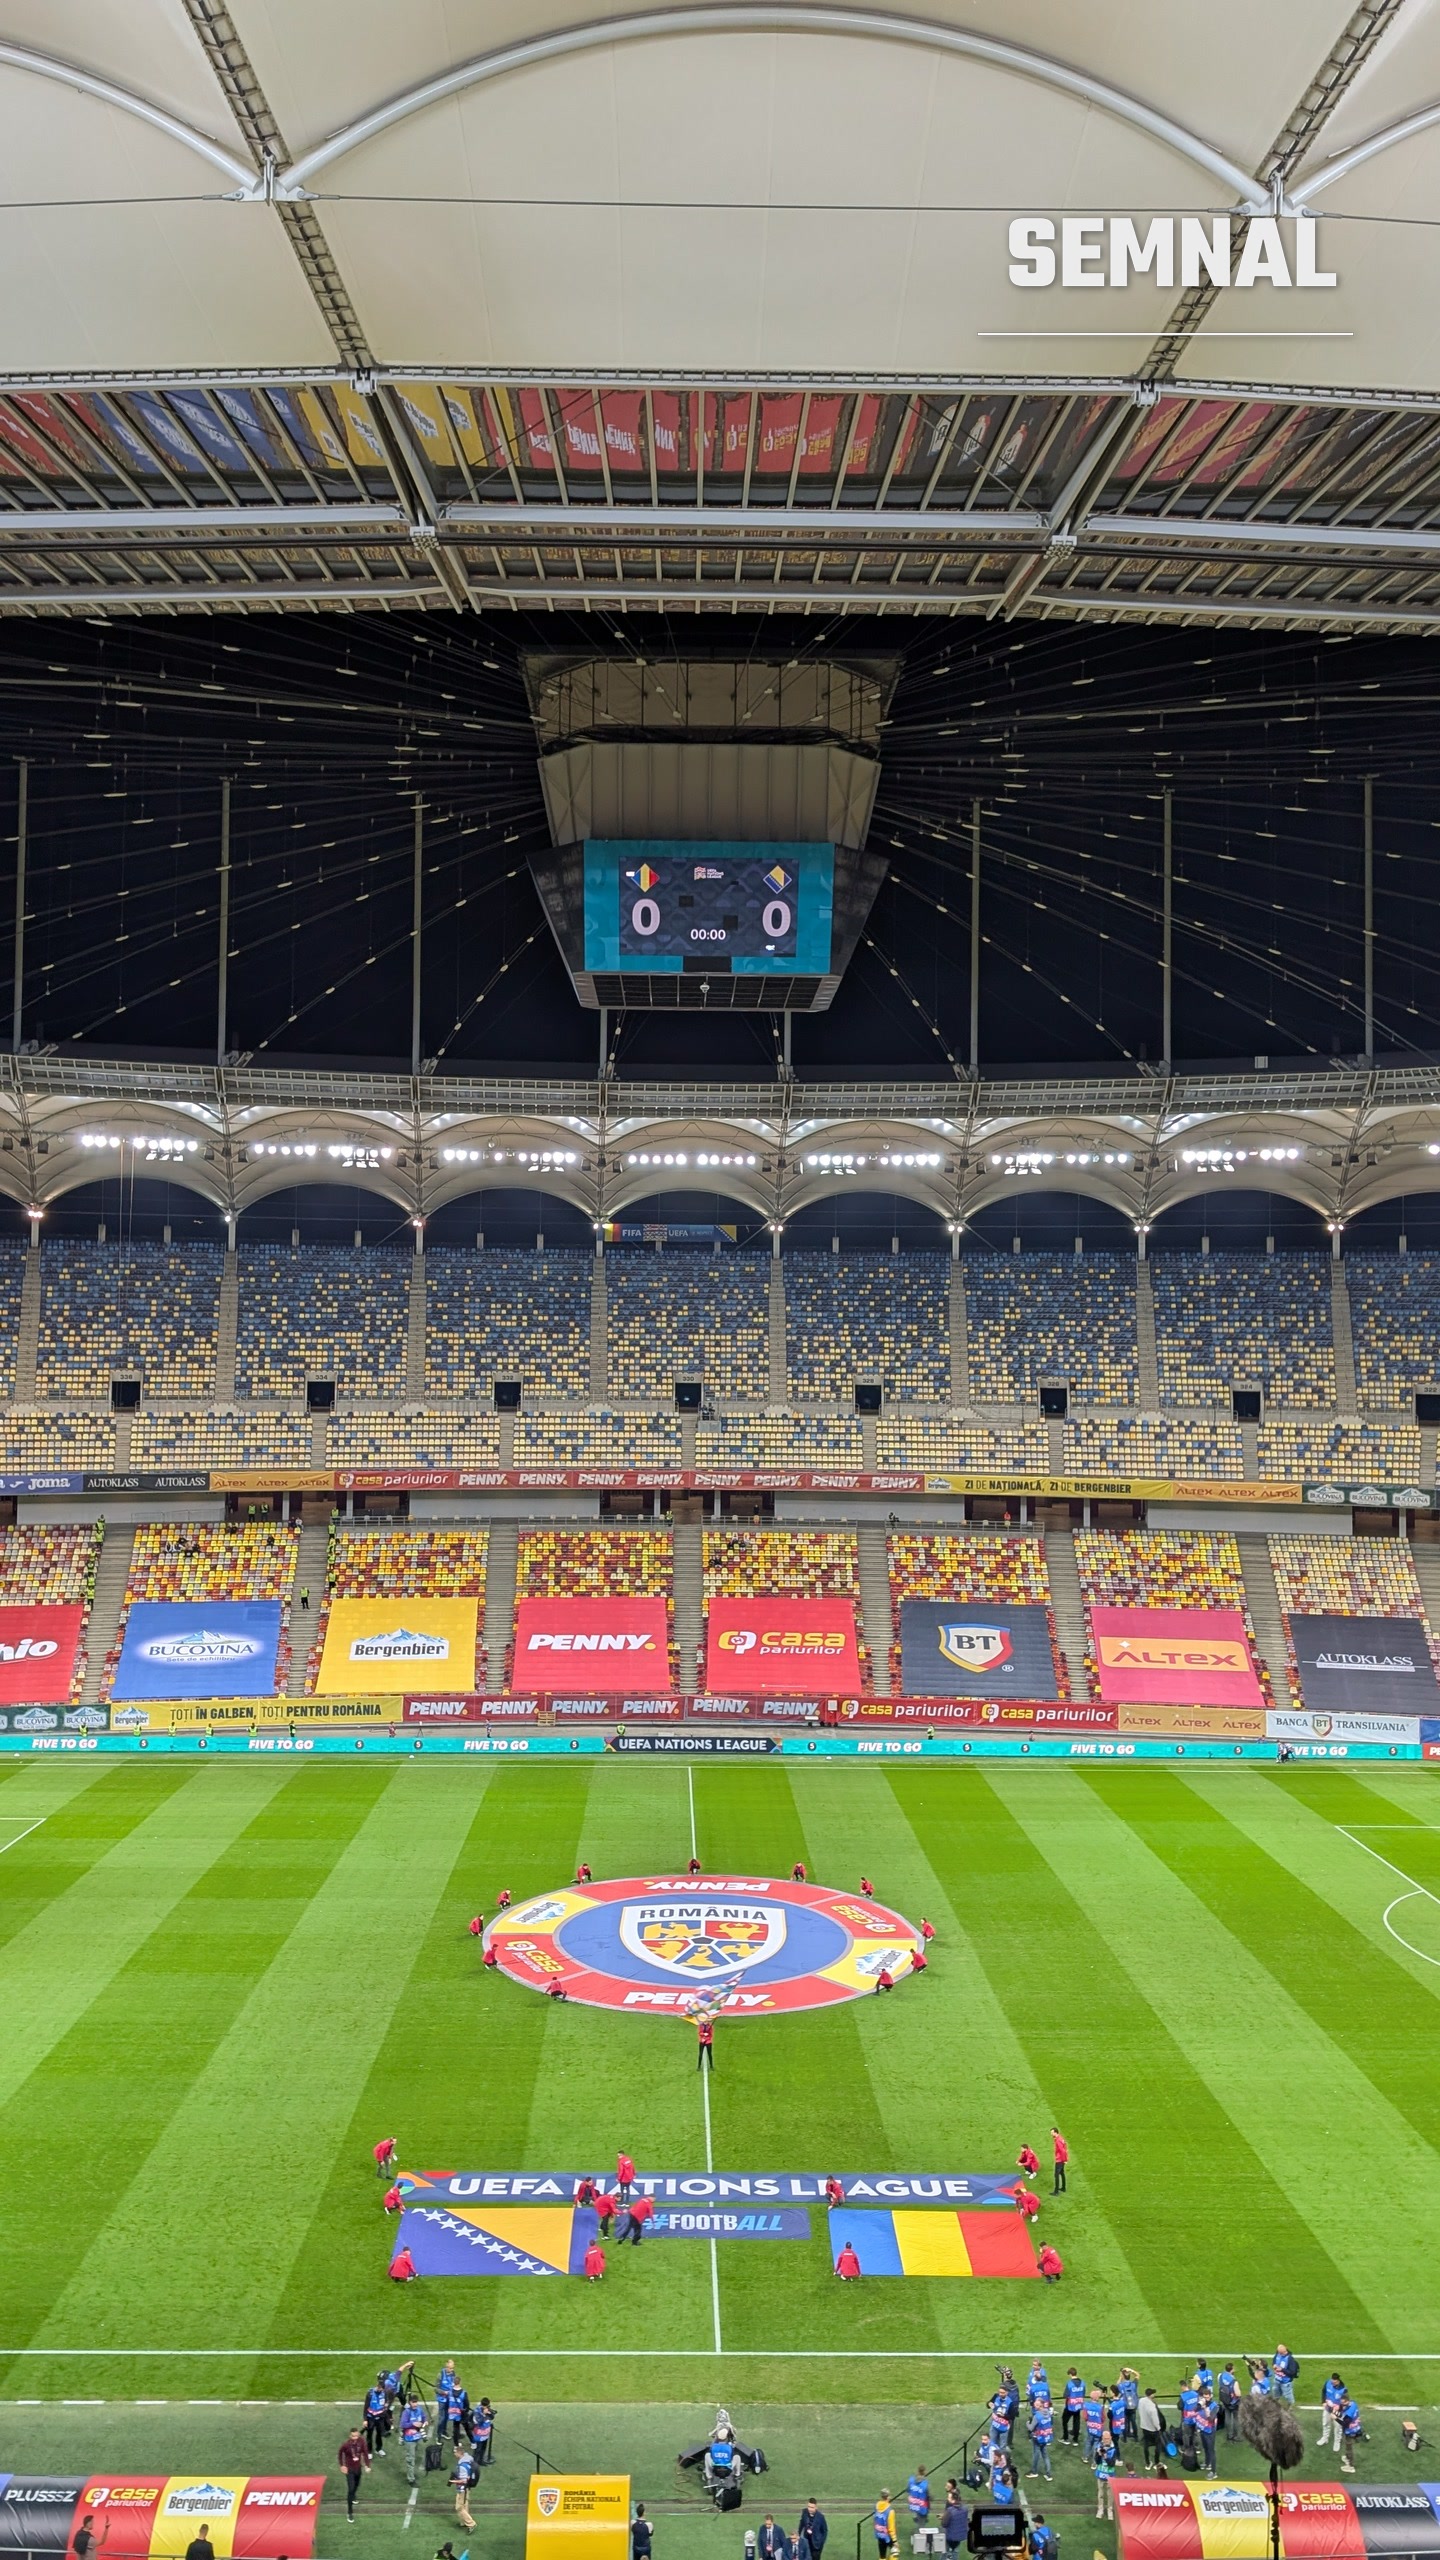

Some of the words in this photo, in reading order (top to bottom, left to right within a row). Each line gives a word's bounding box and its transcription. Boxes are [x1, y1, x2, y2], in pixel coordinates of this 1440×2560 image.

[632, 898, 660, 936] 0
[762, 900, 791, 937] 0
[690, 928, 726, 941] 00:00
[622, 1229, 641, 1237] FIFA
[668, 1229, 688, 1237] UEFA
[88, 1478, 139, 1488] AUTOKLASS
[155, 1476, 206, 1488] AUTOKLASS
[355, 1475, 383, 1486] casa
[384, 1473, 449, 1487] pariurilor
[965, 1481, 974, 1490] ZI
[976, 1481, 987, 1490] DE
[1050, 1481, 1059, 1491] ZI
[1061, 1482, 1072, 1492] DE
[1074, 1482, 1132, 1494] BERGENBIER
[1309, 1492, 1344, 1501] BUCOVINA
[1352, 1493, 1385, 1502] BUCOVINA
[1394, 1495, 1428, 1504] BUCOVINA
[762, 1631, 846, 1647] casa
[954, 1634, 996, 1650] BT
[149, 1644, 254, 1656] BUCOVINA
[354, 1643, 445, 1657] Bergenbier
[760, 1646, 844, 1655] pariurilor
[1316, 1653, 1414, 1666] AUTOKLASS
[195, 1706, 207, 1719] ÎN
[210, 1707, 257, 1720] GALBEN,
[286, 1705, 331, 1717] PENTRU
[332, 1702, 382, 1716] ROMÂNIA
[861, 1704, 893, 1715] casa
[894, 1704, 971, 1718] pariurilor
[1001, 1707, 1034, 1720] casa
[1035, 1707, 1114, 1723] pariurilor
[16, 1717, 56, 1726] BUCOVINA
[1276, 1717, 1308, 1727] BANCA
[1336, 1720, 1406, 1732] TRANSILVANIA
[32, 1738, 58, 1749] FIVE
[61, 1738, 76, 1749] TO
[79, 1738, 98, 1749] GO
[249, 1739, 275, 1750] FIVE
[277, 1739, 293, 1750] TO
[295, 1739, 314, 1750] GO
[463, 1740, 489, 1750] FIVE
[492, 1740, 508, 1750] TO
[510, 1740, 529, 1750] GO
[619, 1738, 652, 1751] UEFA
[655, 1738, 713, 1751] NATIONS
[716, 1738, 767, 1751] LEAGUE
[857, 1742, 884, 1753] FIVE
[887, 1742, 902, 1753] TO
[903, 1742, 922, 1753] GO
[1071, 1744, 1097, 1755] FIVE
[1099, 1744, 1115, 1755] TO
[1116, 1744, 1136, 1755] GO
[1311, 1746, 1327, 1756] TO
[1329, 1746, 1348, 1757] GO
[640, 1906, 767, 1920] ROMÂNIA
[525, 1949, 565, 1973] casa
[449, 2178, 565, 2195] UEFA
[4, 2489, 77, 2503] PLUSSSZ
[110, 2488, 159, 2500] casa
[1298, 2493, 1346, 2504] casa
[105, 2499, 154, 2508] pariurilor
[168, 2495, 232, 2511] Bergenbier
[1203, 2498, 1266, 2514] Bergenbier
[1301, 2503, 1347, 2512] pariurilor
[1356, 2495, 1430, 2508] AUTOKLASS
